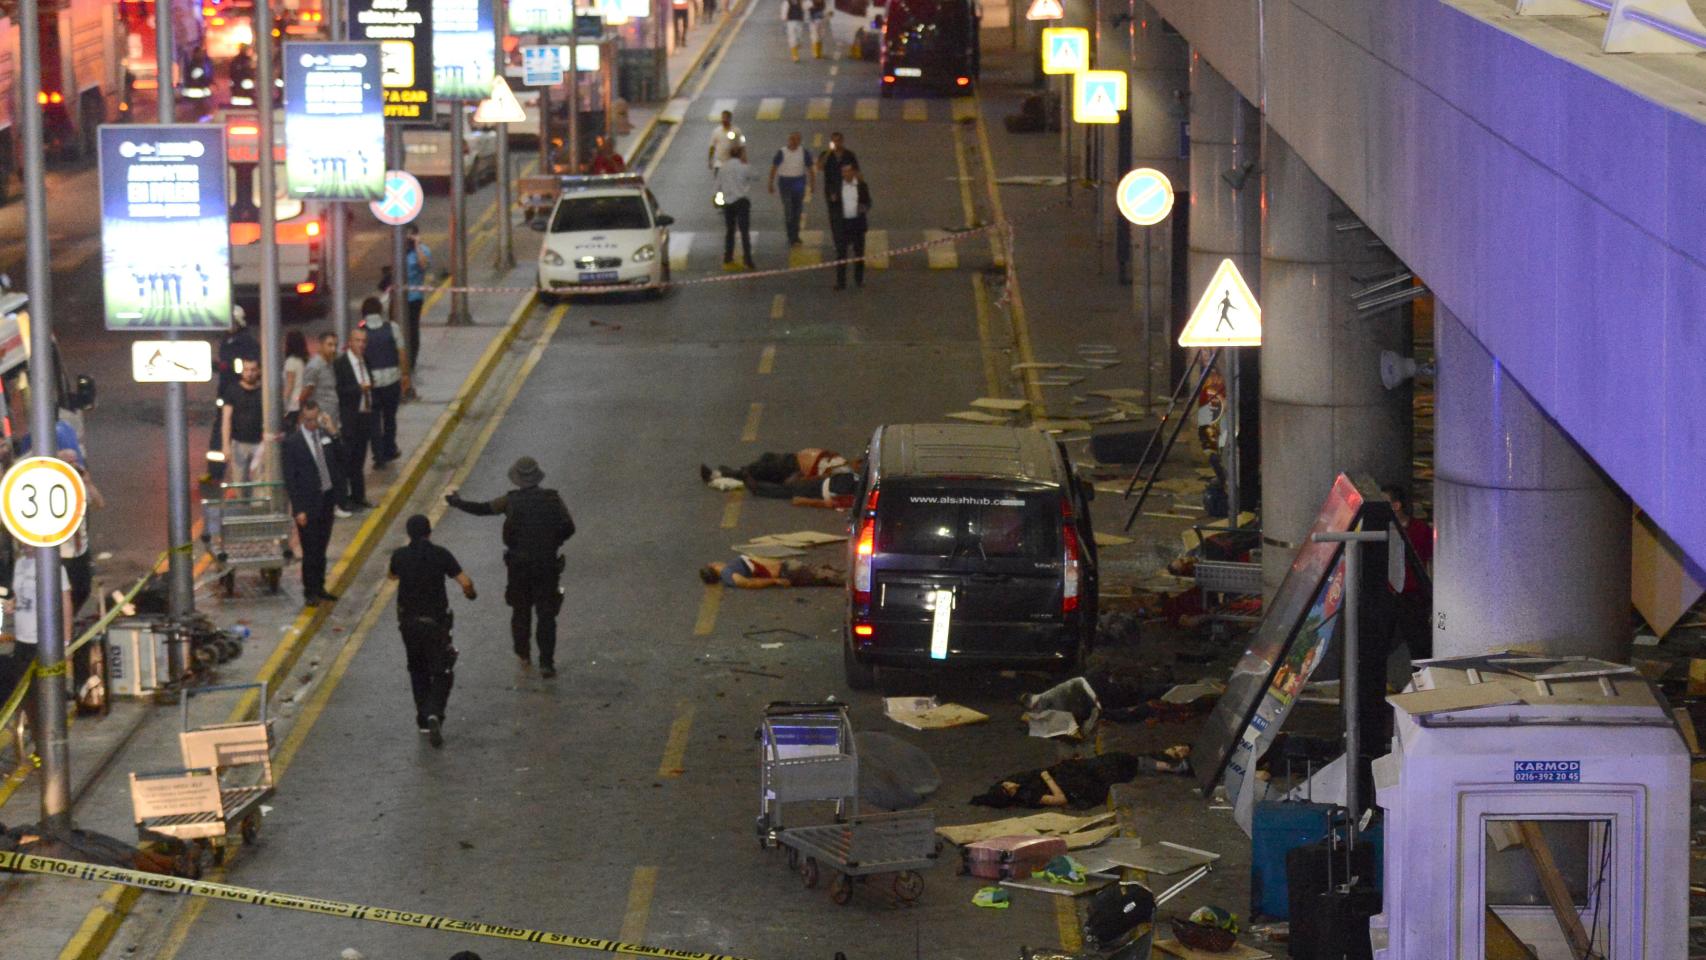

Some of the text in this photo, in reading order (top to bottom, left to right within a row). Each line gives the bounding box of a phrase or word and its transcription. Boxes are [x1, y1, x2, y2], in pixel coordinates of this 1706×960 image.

[21, 484, 68, 518] 30
[910, 496, 1020, 506] www.alsahhab.c
[1515, 762, 1579, 771] KARMOD
[1515, 773, 1579, 781] 0216-392 20 45
